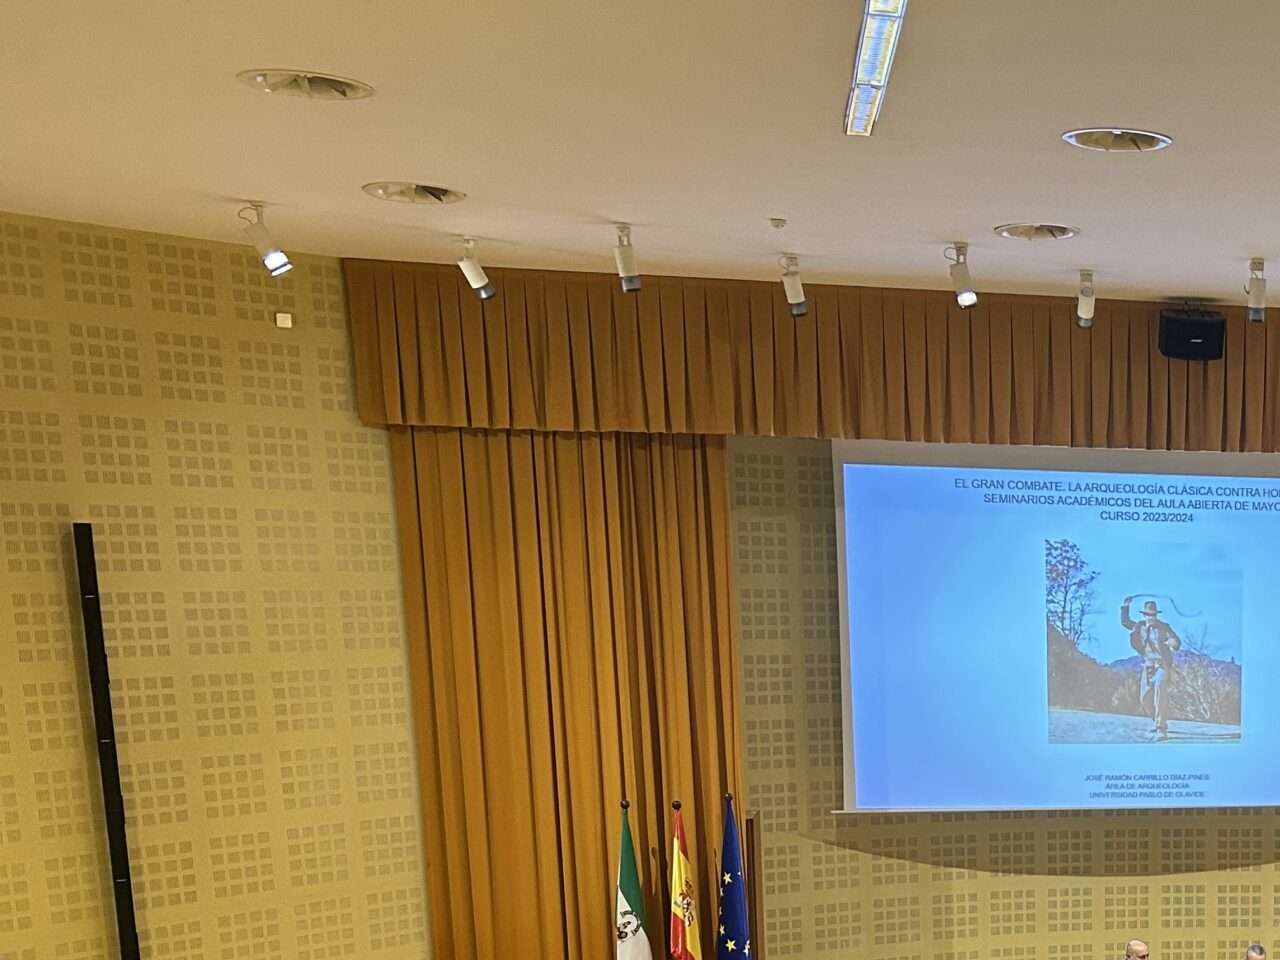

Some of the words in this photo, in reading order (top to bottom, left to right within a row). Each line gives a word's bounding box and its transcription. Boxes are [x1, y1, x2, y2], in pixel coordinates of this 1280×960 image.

[954, 478, 968, 488] EL
[971, 479, 1004, 489] GRAN
[1007, 480, 1066, 492] COMBATE.
[1068, 482, 1083, 492] LA
[1083, 482, 1168, 494] ARQUEOLOGÍA
[1167, 484, 1213, 496] CLÁSICA
[1215, 486, 1261, 498] CONTRA
[983, 493, 1054, 505] SEMINARIOS
[1057, 495, 1131, 507] ACADÉMICOS
[1134, 498, 1157, 508] DEL
[1157, 498, 1189, 509] AULA
[1187, 499, 1232, 511] ABIERTA
[1234, 501, 1249, 511] DE
[1100, 511, 1140, 521] CURSO
[1143, 511, 1194, 522] 2023/2024
